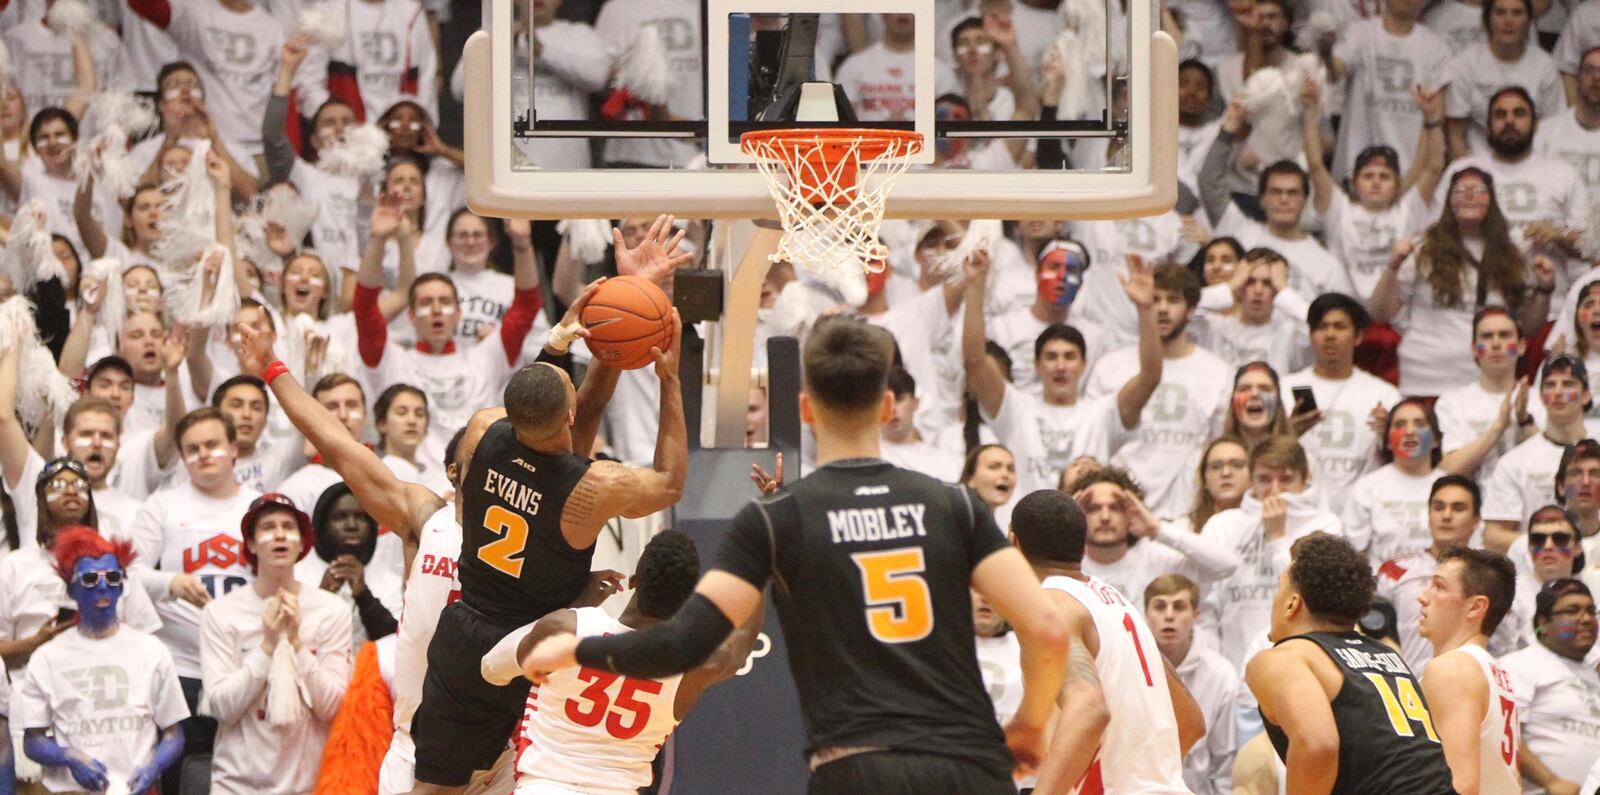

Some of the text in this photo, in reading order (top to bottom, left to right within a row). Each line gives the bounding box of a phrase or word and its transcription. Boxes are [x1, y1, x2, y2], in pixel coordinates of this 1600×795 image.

[484, 468, 543, 516] EVANS
[827, 503, 927, 543] MOBLEY
[477, 504, 529, 579] 2
[850, 546, 934, 644] 5
[1123, 612, 1154, 688] 1
[564, 666, 663, 739] 35
[1362, 672, 1441, 743] 14
